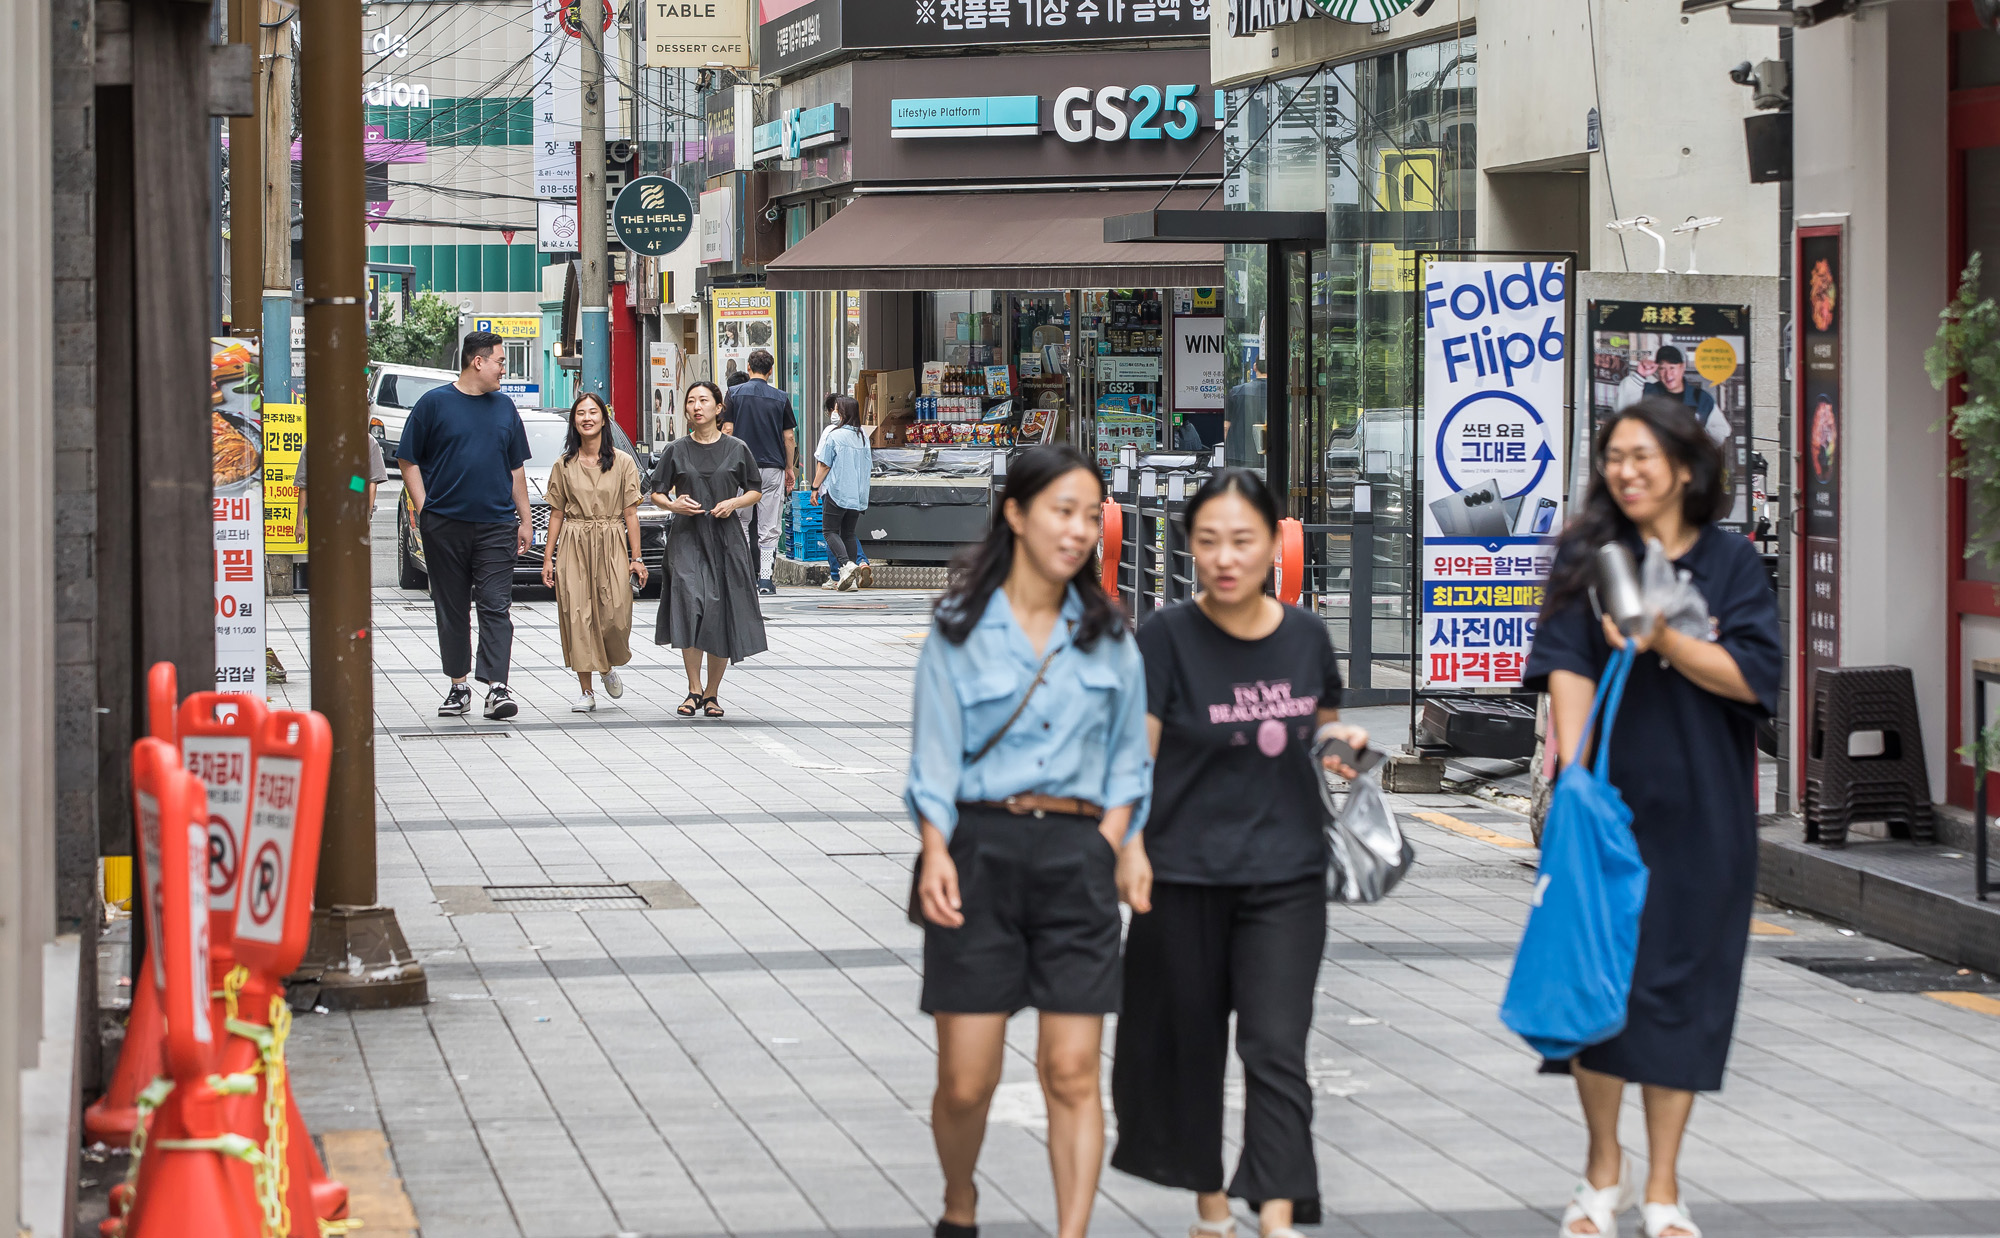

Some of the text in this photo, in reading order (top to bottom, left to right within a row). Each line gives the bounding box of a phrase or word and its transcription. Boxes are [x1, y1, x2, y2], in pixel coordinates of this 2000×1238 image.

[657, 3, 716, 18] TABLE
[372, 25, 409, 59] de
[657, 44, 741, 53] DESSERT CAFE
[362, 75, 430, 108] alon
[898, 106, 981, 120] Lifestyle Platform
[1053, 84, 1200, 143] GS25
[620, 215, 645, 225] THE
[647, 240, 662, 250] 4F
[717, 296, 771, 308] 퍼스트헤어
[1426, 262, 1566, 329] Fold6
[493, 326, 537, 335] 주차 관리실
[1442, 316, 1565, 387] Flip6
[1108, 382, 1135, 393] GS25
[1462, 423, 1525, 438] 쓰던 요금
[1460, 441, 1527, 463] 그대로
[213, 497, 251, 522] 갈비
[215, 529, 250, 541] 셀프바
[276, 525, 294, 537] 만원
[232, 626, 257, 636] 11,000
[215, 666, 256, 683] 삼겹살
[1430, 652, 1530, 683] 파격할
